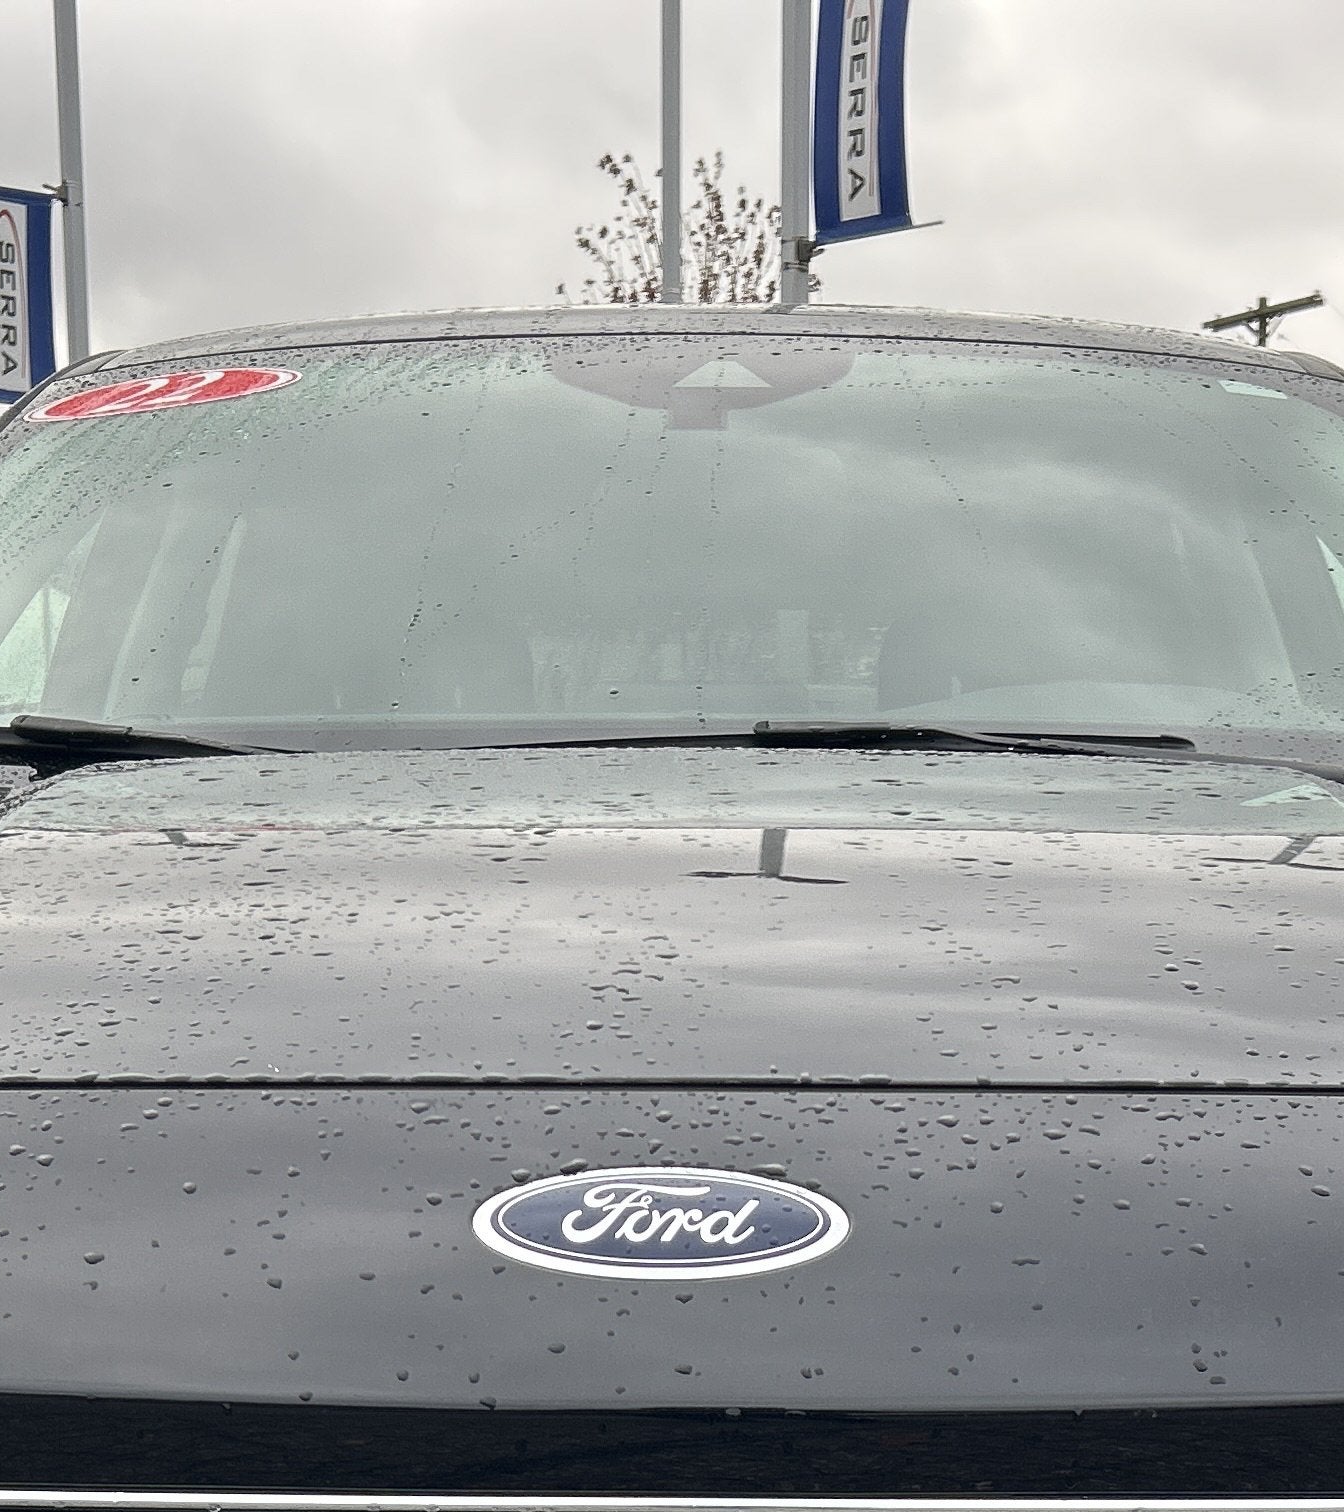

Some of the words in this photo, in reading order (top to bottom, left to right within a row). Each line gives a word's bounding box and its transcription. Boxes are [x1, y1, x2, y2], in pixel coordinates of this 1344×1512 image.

[847, 15, 869, 202] SERRA
[88, 371, 225, 416] 22
[561, 1183, 760, 1245] Ford
